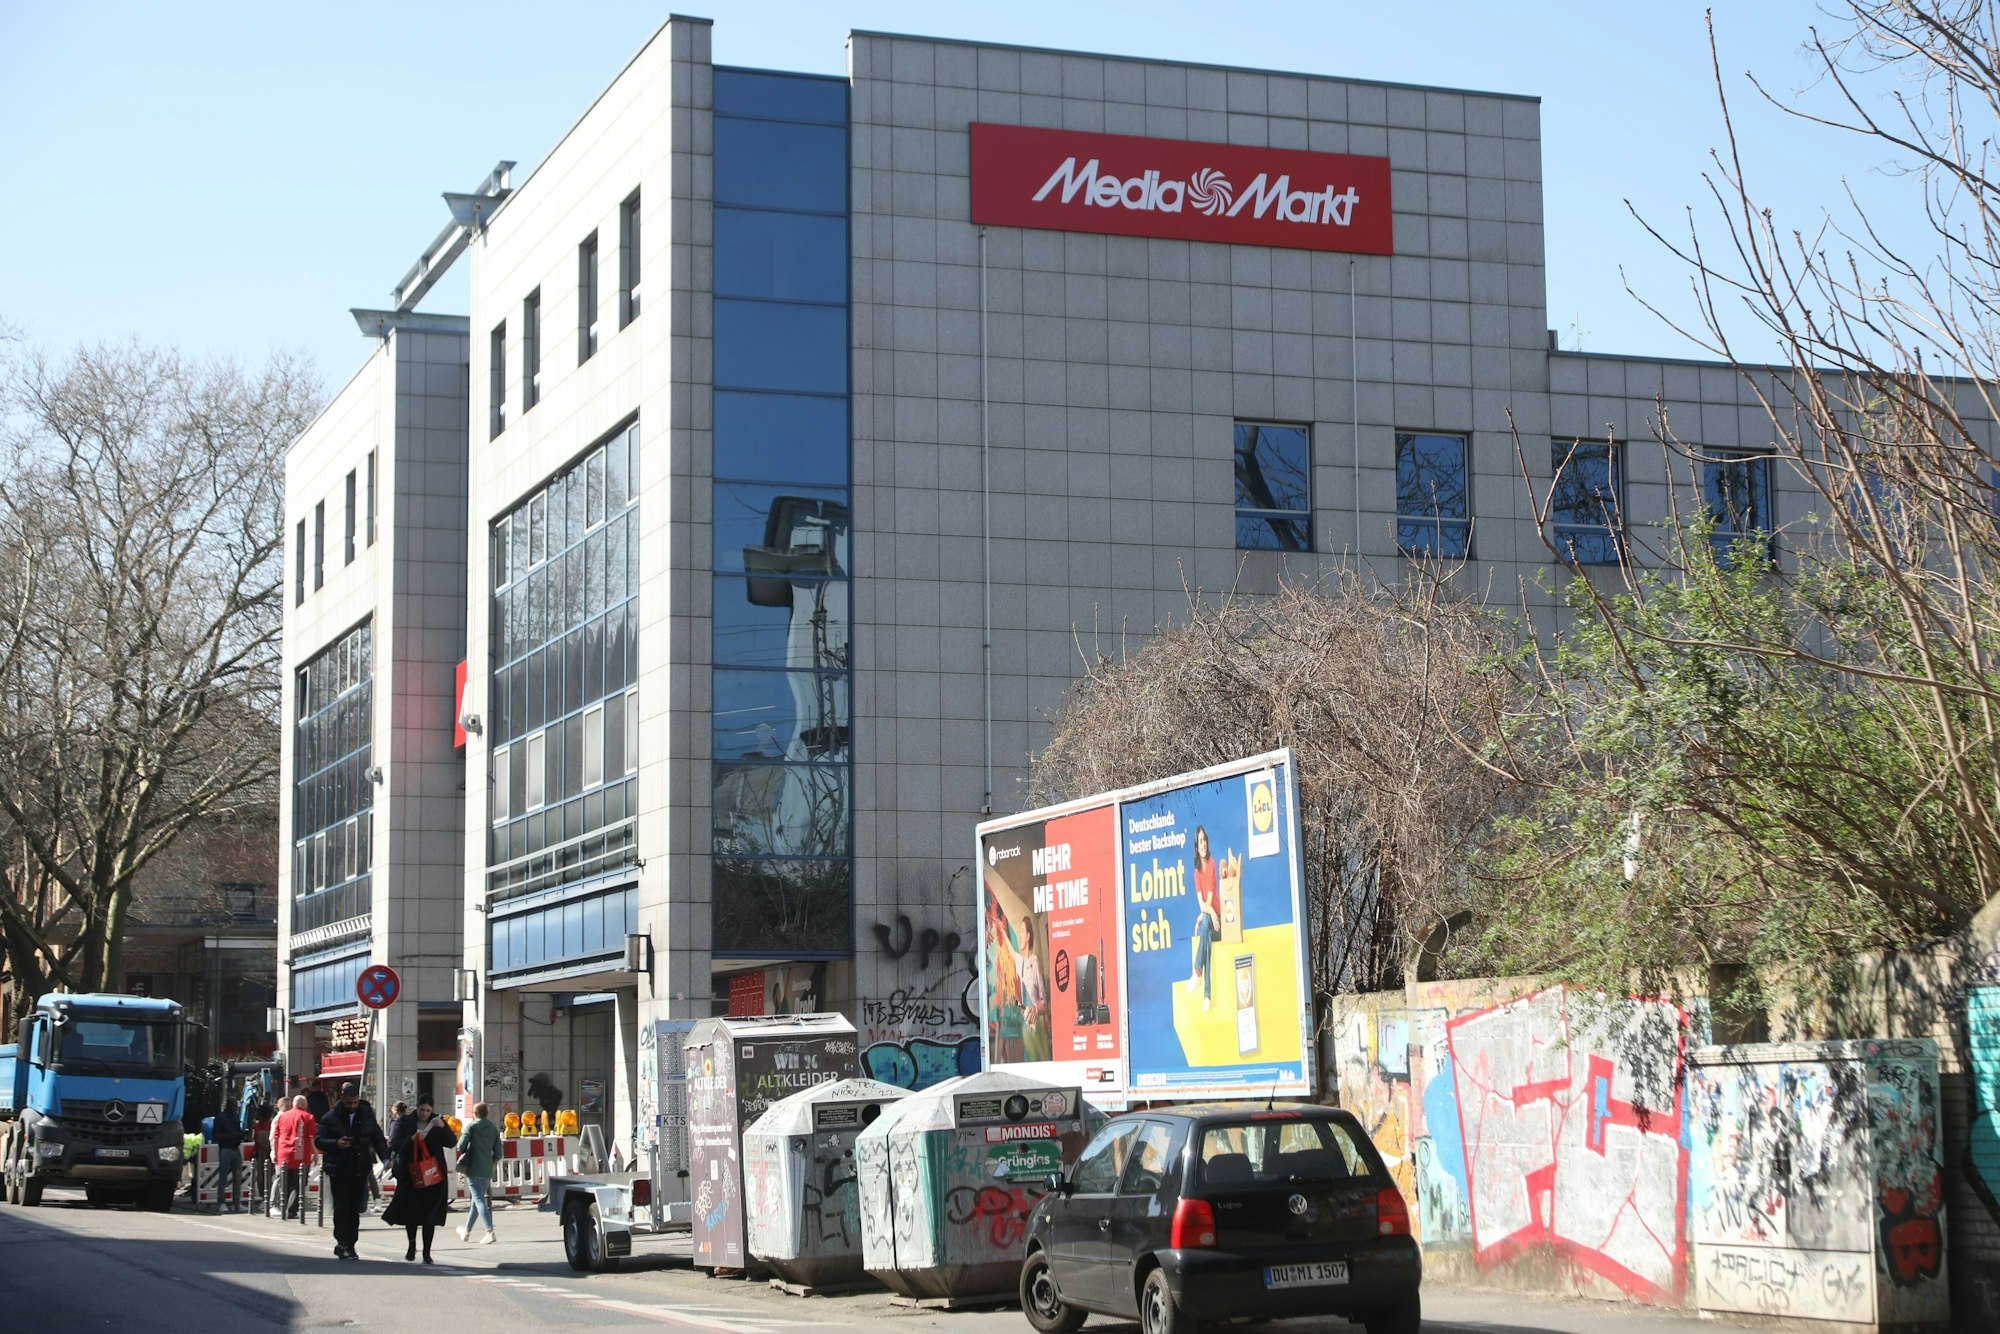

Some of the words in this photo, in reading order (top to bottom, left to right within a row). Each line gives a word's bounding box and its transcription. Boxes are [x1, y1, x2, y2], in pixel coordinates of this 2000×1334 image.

[1032, 157, 1186, 213] Media
[1225, 173, 1360, 227] Markt
[1129, 811, 1175, 834] Deutschlands
[996, 846, 1021, 861] roborock
[1129, 839, 1152, 855] bester
[1032, 843, 1072, 877] MEHR
[1130, 858, 1186, 904] Lohnt
[1033, 884, 1055, 914] ME
[1056, 877, 1089, 910] TIME
[1132, 908, 1172, 953] sich
[140, 1106, 159, 1122] A
[663, 1116, 669, 1126] K
[1273, 1266, 1289, 1282] DU
[1298, 1264, 1314, 1280] MI
[1318, 1263, 1346, 1279] 1507
